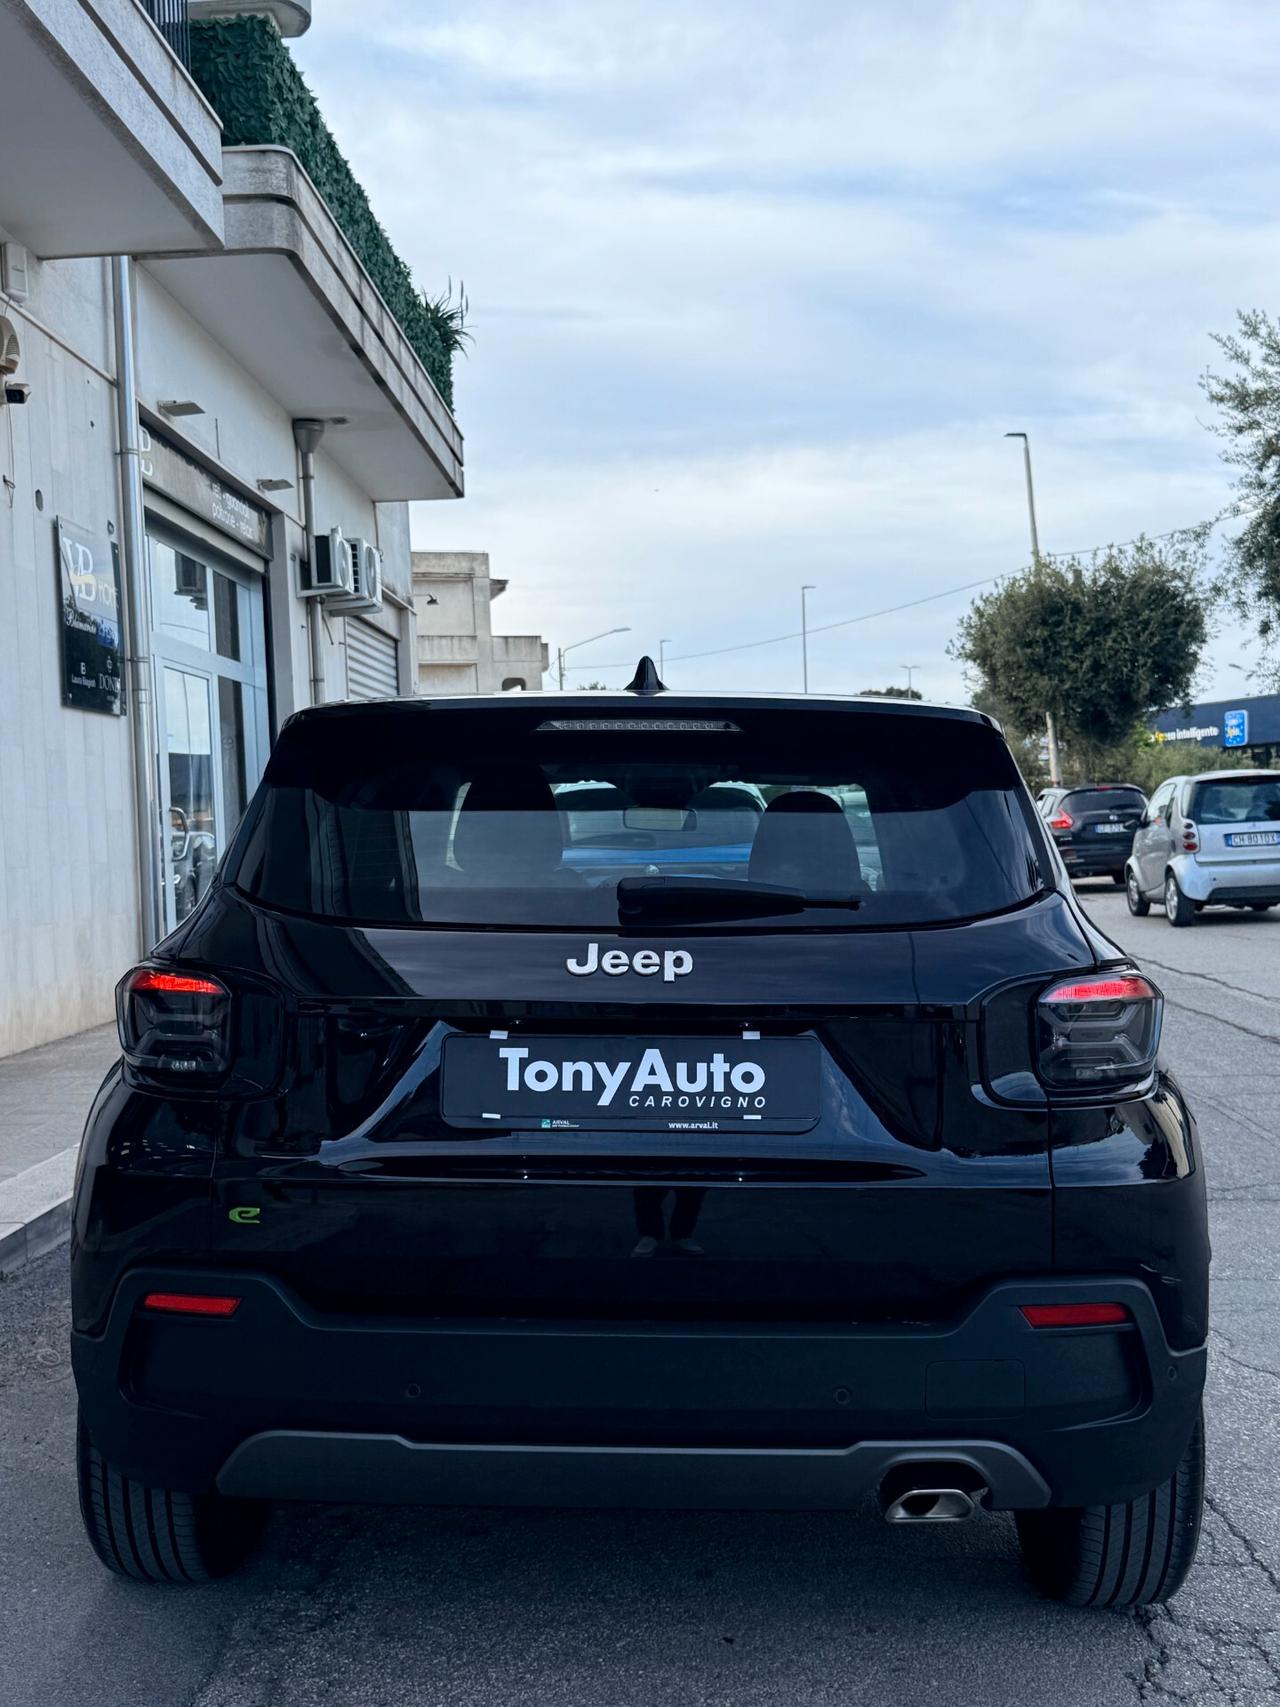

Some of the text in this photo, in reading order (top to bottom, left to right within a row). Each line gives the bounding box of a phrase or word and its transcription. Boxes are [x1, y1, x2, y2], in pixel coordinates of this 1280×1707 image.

[1176, 726, 1219, 741] intelligente
[566, 943, 694, 983] Jeep
[499, 1047, 766, 1107] TonyAuto
[629, 1095, 766, 1109] CAROVIGNO
[668, 1120, 719, 1129] www.arval.it
